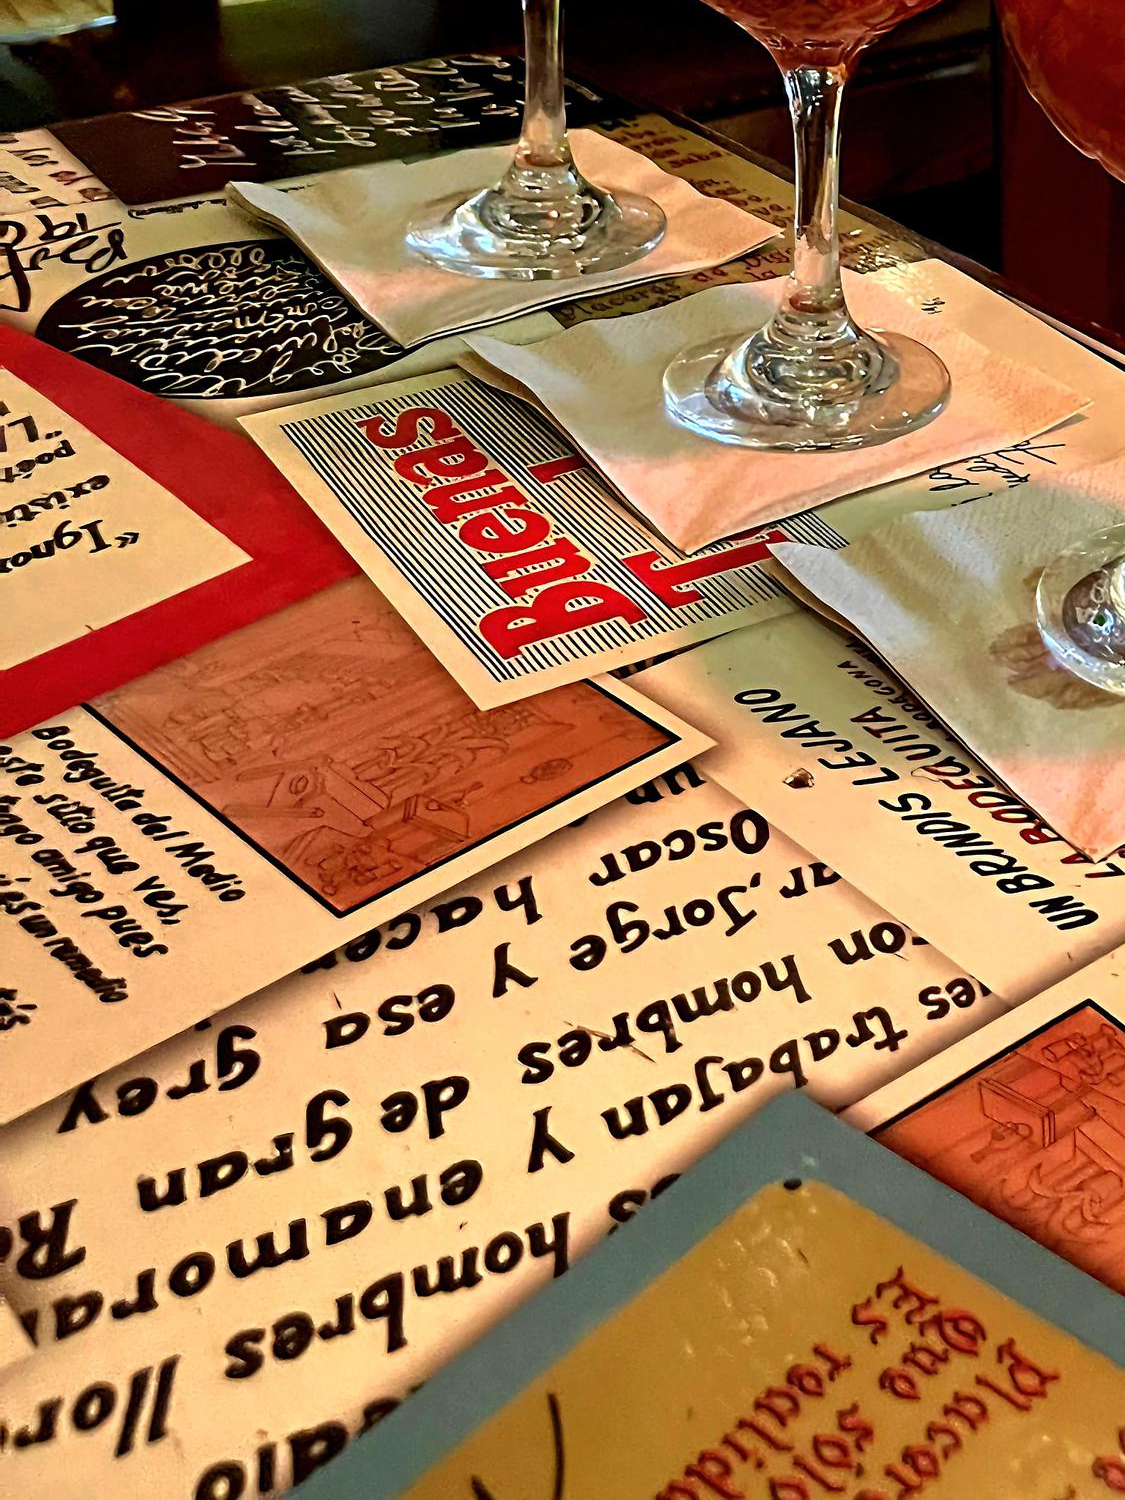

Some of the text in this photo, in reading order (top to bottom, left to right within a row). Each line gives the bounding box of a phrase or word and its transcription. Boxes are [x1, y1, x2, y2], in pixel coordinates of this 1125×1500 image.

[352, 405, 652, 660] Buenas
[588, 807, 771, 888] Oscar
[733, 687, 1099, 932] UN BRINDIS LEJANO
[165, 842, 247, 901] Medio
[569, 884, 758, 971] Jorge
[828, 921, 929, 967] on
[323, 983, 457, 1050] esa
[516, 953, 813, 1087] hombres
[57, 1024, 263, 1134] grey
[379, 1075, 471, 1141] de
[135, 1088, 353, 1213] gran
[15, 1158, 484, 1350] enamora
[0, 1210, 571, 1459] hombres llor
[851, 1266, 941, 1346] Es
[877, 1307, 988, 1402] Que
